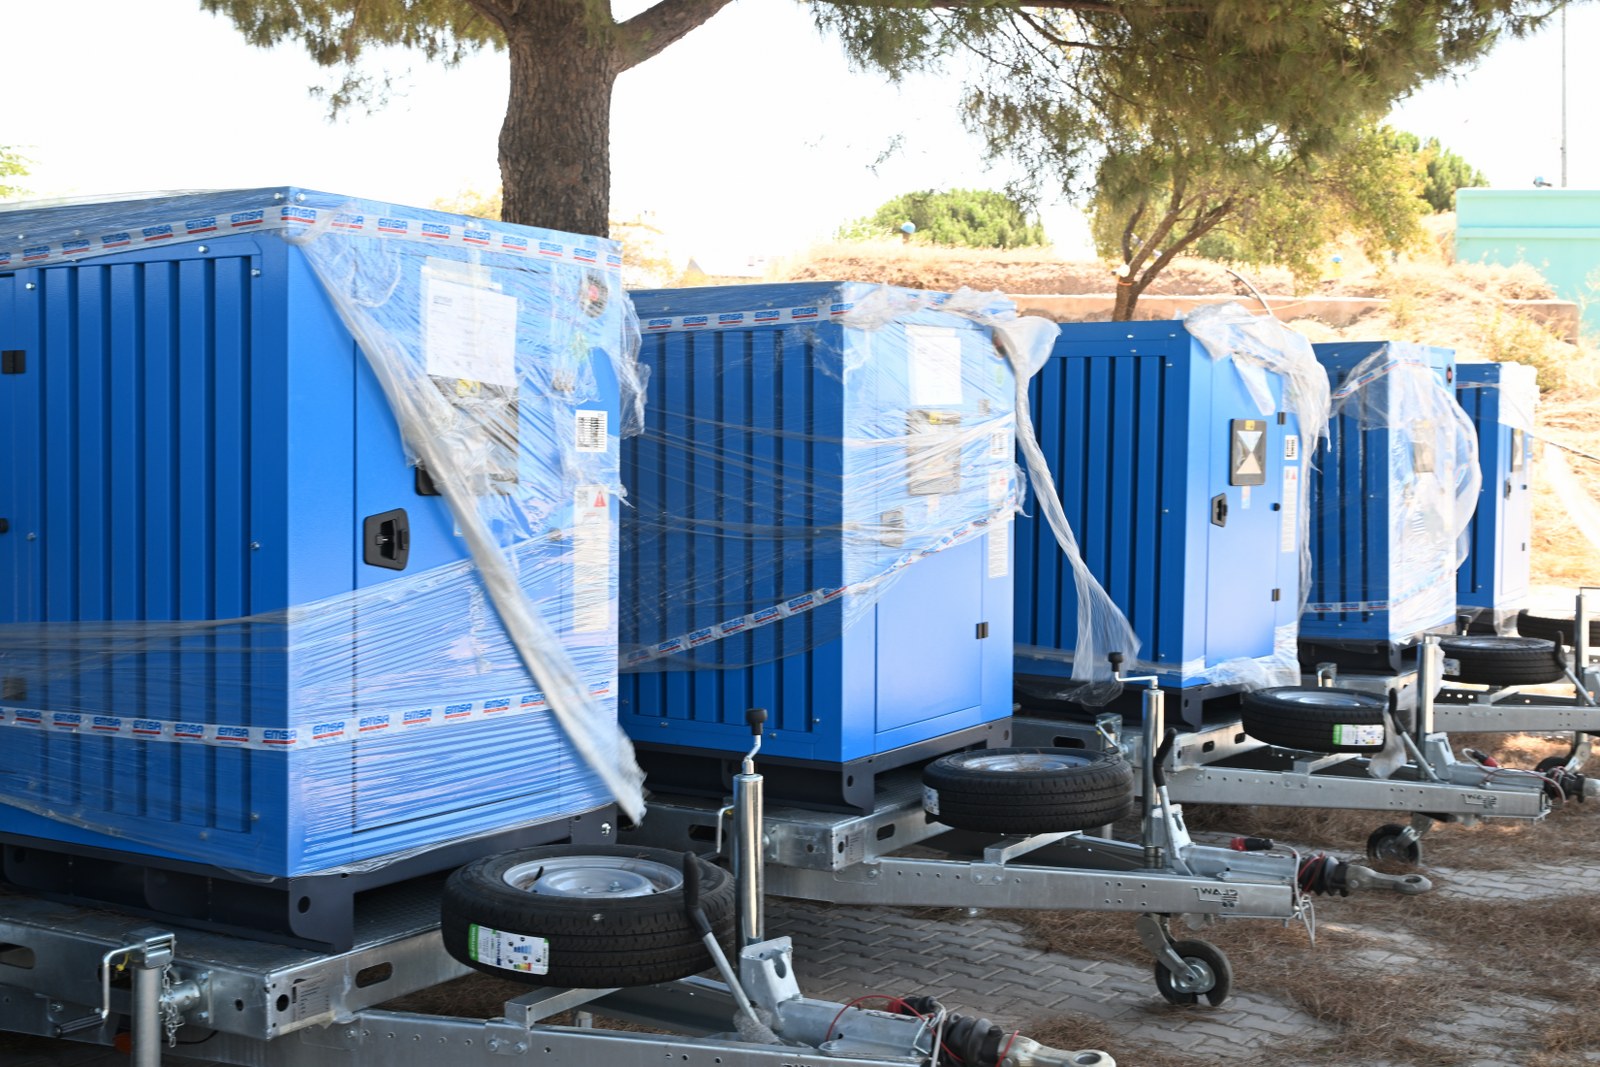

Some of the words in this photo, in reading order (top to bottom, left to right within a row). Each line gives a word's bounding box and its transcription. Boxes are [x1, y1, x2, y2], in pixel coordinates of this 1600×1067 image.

[61, 239, 90, 249] EMSA
[101, 232, 131, 244] EMSA
[142, 224, 173, 237] EMSA
[185, 217, 217, 230] EMSA
[230, 210, 265, 223] EMSA
[281, 206, 317, 219] EMSA
[377, 217, 408, 229] EMSA
[421, 223, 451, 235] EMSA
[463, 229, 492, 240] EMSA
[502, 235, 528, 247] EMSA
[539, 241, 564, 252] EMSA
[573, 247, 598, 258] EMSA
[648, 318, 673, 327] EMSA
[683, 315, 709, 324] EMSA
[718, 313, 744, 322] EMSA
[754, 310, 780, 319] EMSA
[791, 307, 818, 316] EMSA
[754, 606, 778, 620] EMSA
[788, 594, 813, 608] EMSA
[53, 712, 81, 723] EMSA
[93, 716, 121, 726] EMSA
[133, 720, 162, 730] EMSA
[174, 723, 204, 734] EMSA
[217, 727, 249, 736] EMSA
[263, 729, 297, 740] EMSA
[312, 721, 345, 735] EMSA
[359, 714, 390, 727] EMSA
[403, 708, 432, 720] EMSA
[444, 703, 473, 715] EMSA
[484, 697, 510, 709] EMSA
